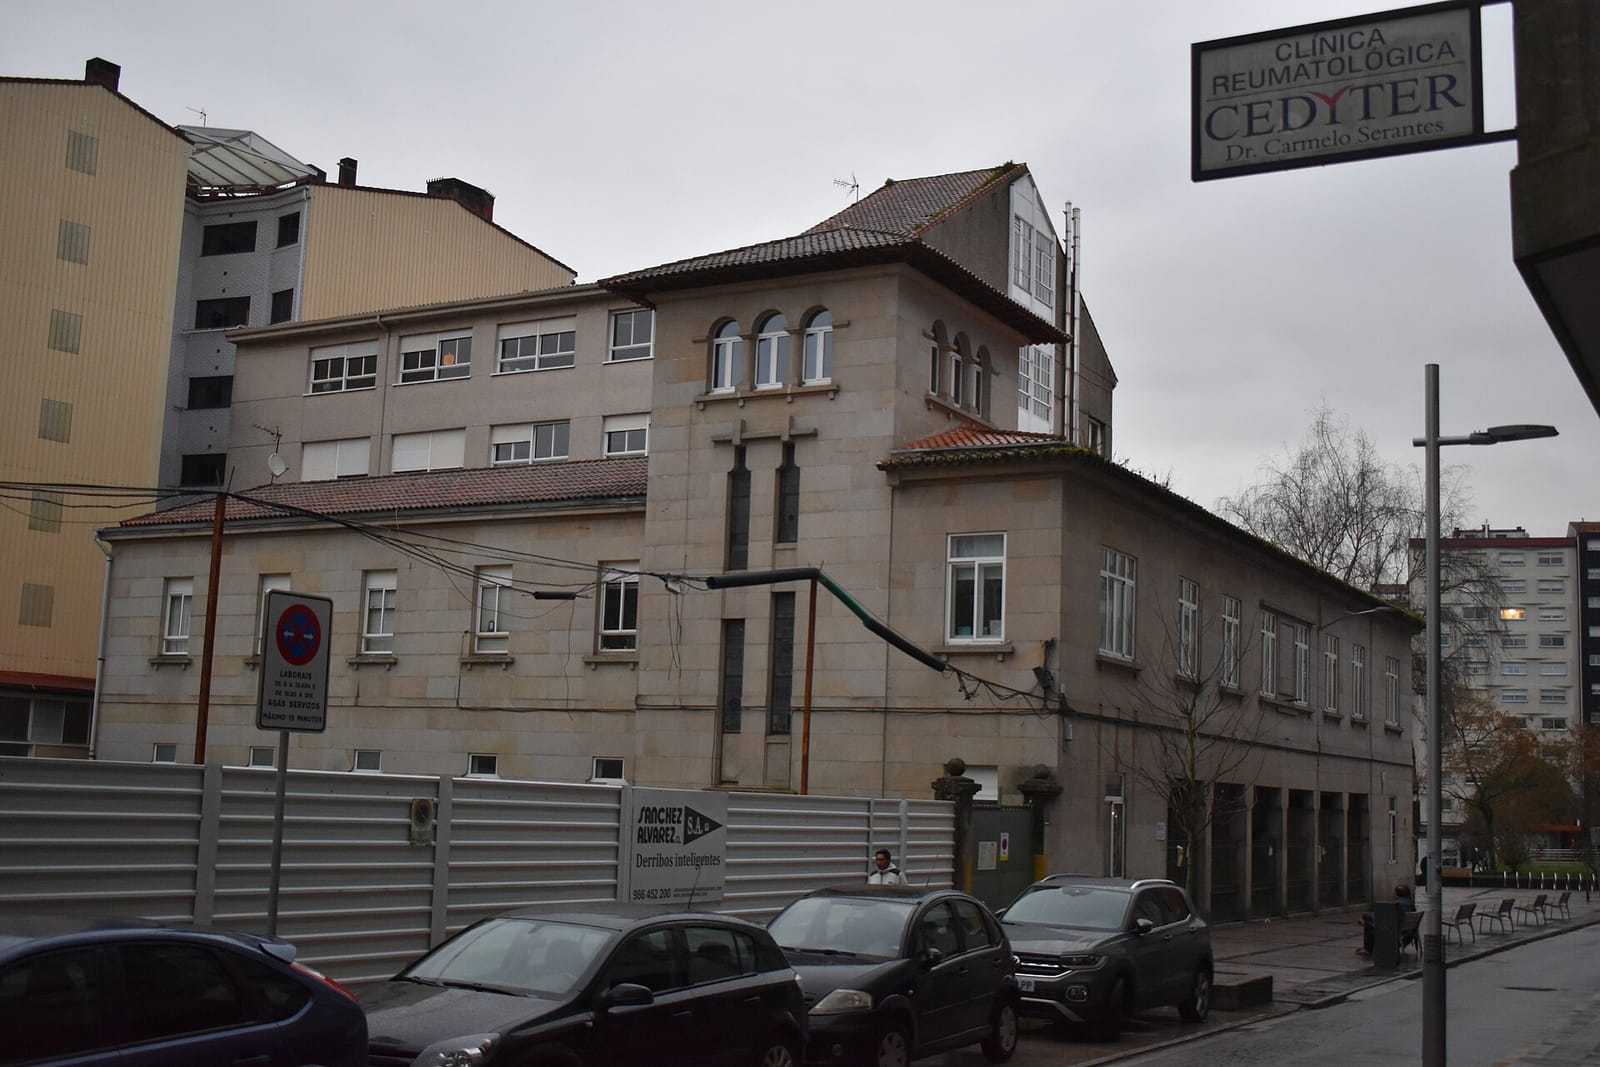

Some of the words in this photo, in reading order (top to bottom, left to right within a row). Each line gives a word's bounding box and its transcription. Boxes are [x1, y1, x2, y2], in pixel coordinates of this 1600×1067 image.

[1275, 27, 1386, 62] CLÍNICA
[1212, 40, 1456, 96] REUMATOLÓGICA
[1204, 73, 1466, 142] CEDYTER
[1225, 144, 1257, 162] Dr.
[1263, 129, 1351, 157] Carmelo
[1357, 119, 1445, 144] Serantes
[637, 806, 683, 825] SANCHEZ
[637, 826, 676, 844] ALVAREZ
[636, 853, 674, 868] Derribos
[675, 852, 721, 870] inteligentes
[646, 888, 658, 899] 452
[659, 887, 672, 899] 200
